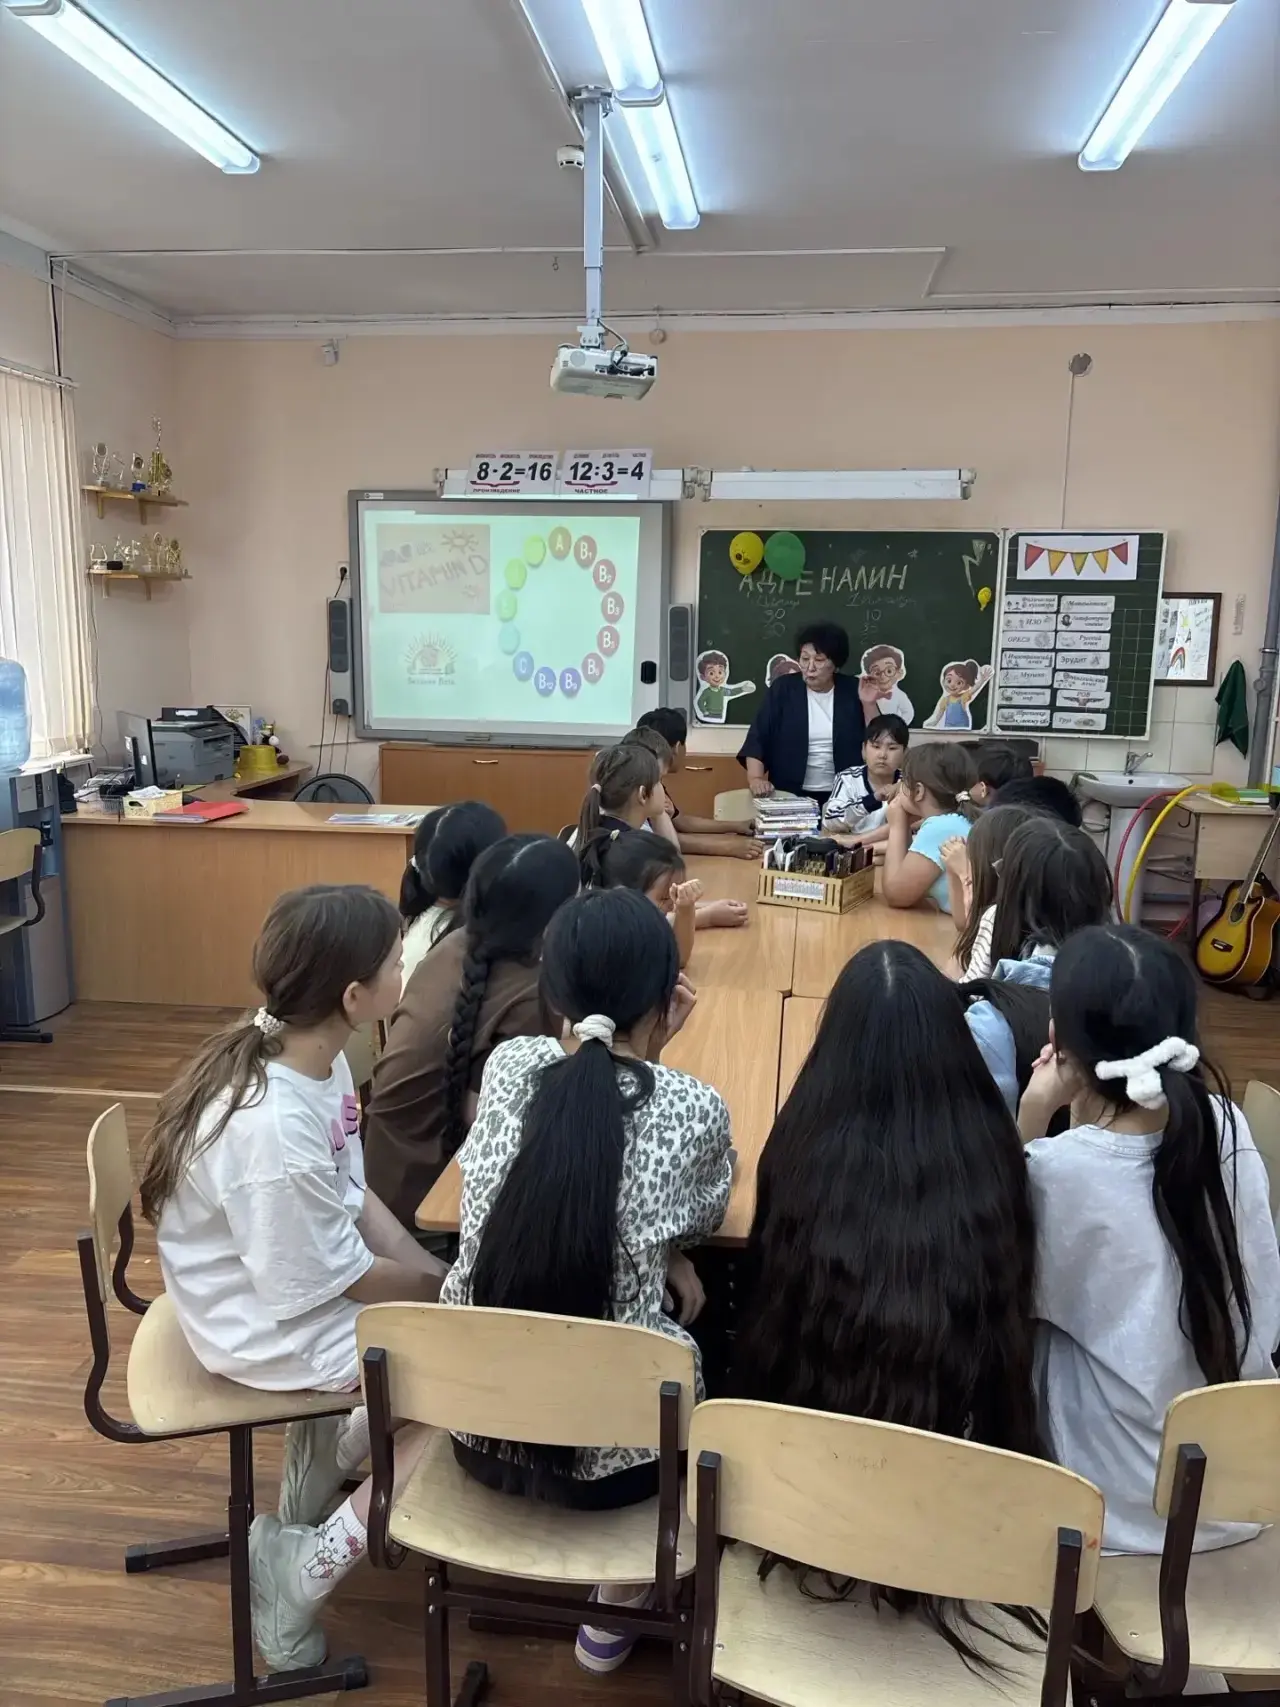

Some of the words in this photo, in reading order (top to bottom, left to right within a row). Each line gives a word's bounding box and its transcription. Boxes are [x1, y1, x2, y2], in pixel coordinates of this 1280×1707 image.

[555, 534, 564, 551] A
[468, 554, 489, 576] D
[1060, 656, 1088, 665] Эрудит
[1020, 672, 1045, 680] Музыка
